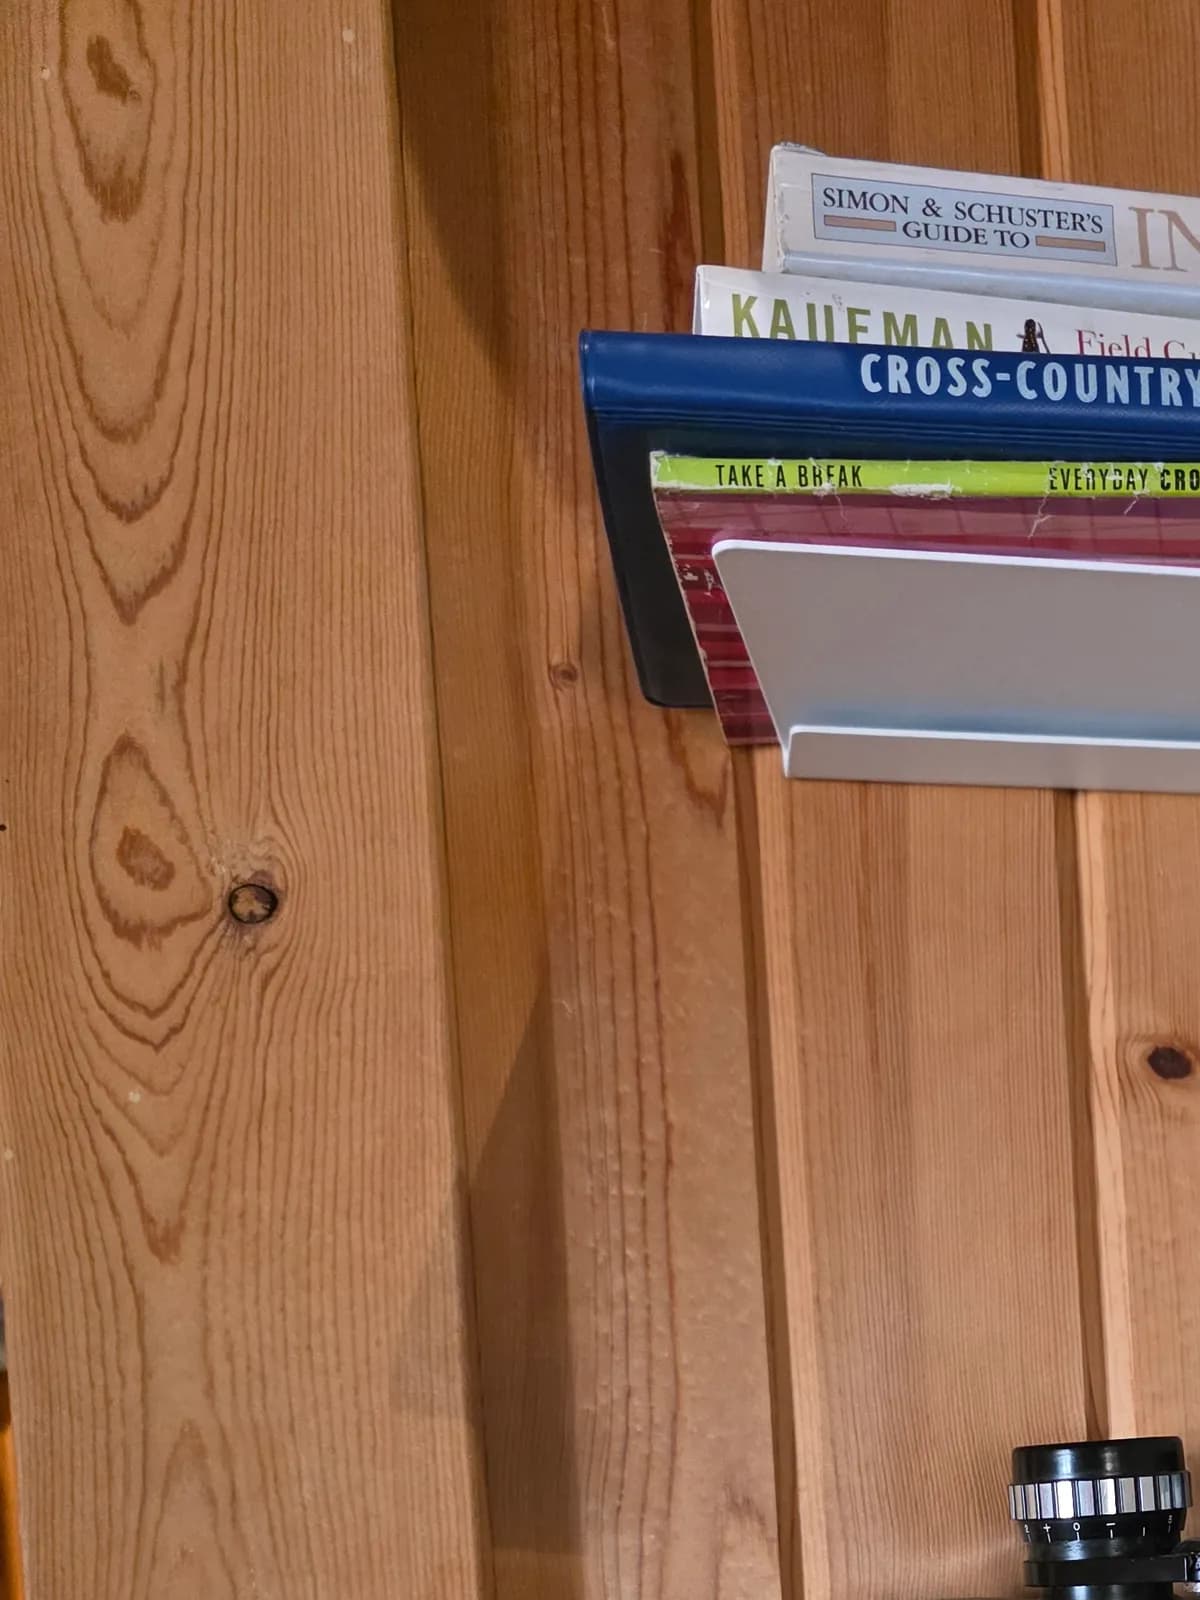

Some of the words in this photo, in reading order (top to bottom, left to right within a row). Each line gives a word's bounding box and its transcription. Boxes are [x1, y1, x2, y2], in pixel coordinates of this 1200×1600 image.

[823, 187, 910, 216] SIMON
[922, 198, 941, 217] &
[954, 201, 1104, 234] SCHUSTER'S
[902, 221, 987, 246] GUIDE
[994, 229, 1030, 249] TO
[716, 465, 764, 488] TAKE
[776, 467, 787, 488] A
[799, 465, 863, 488] BREAK
